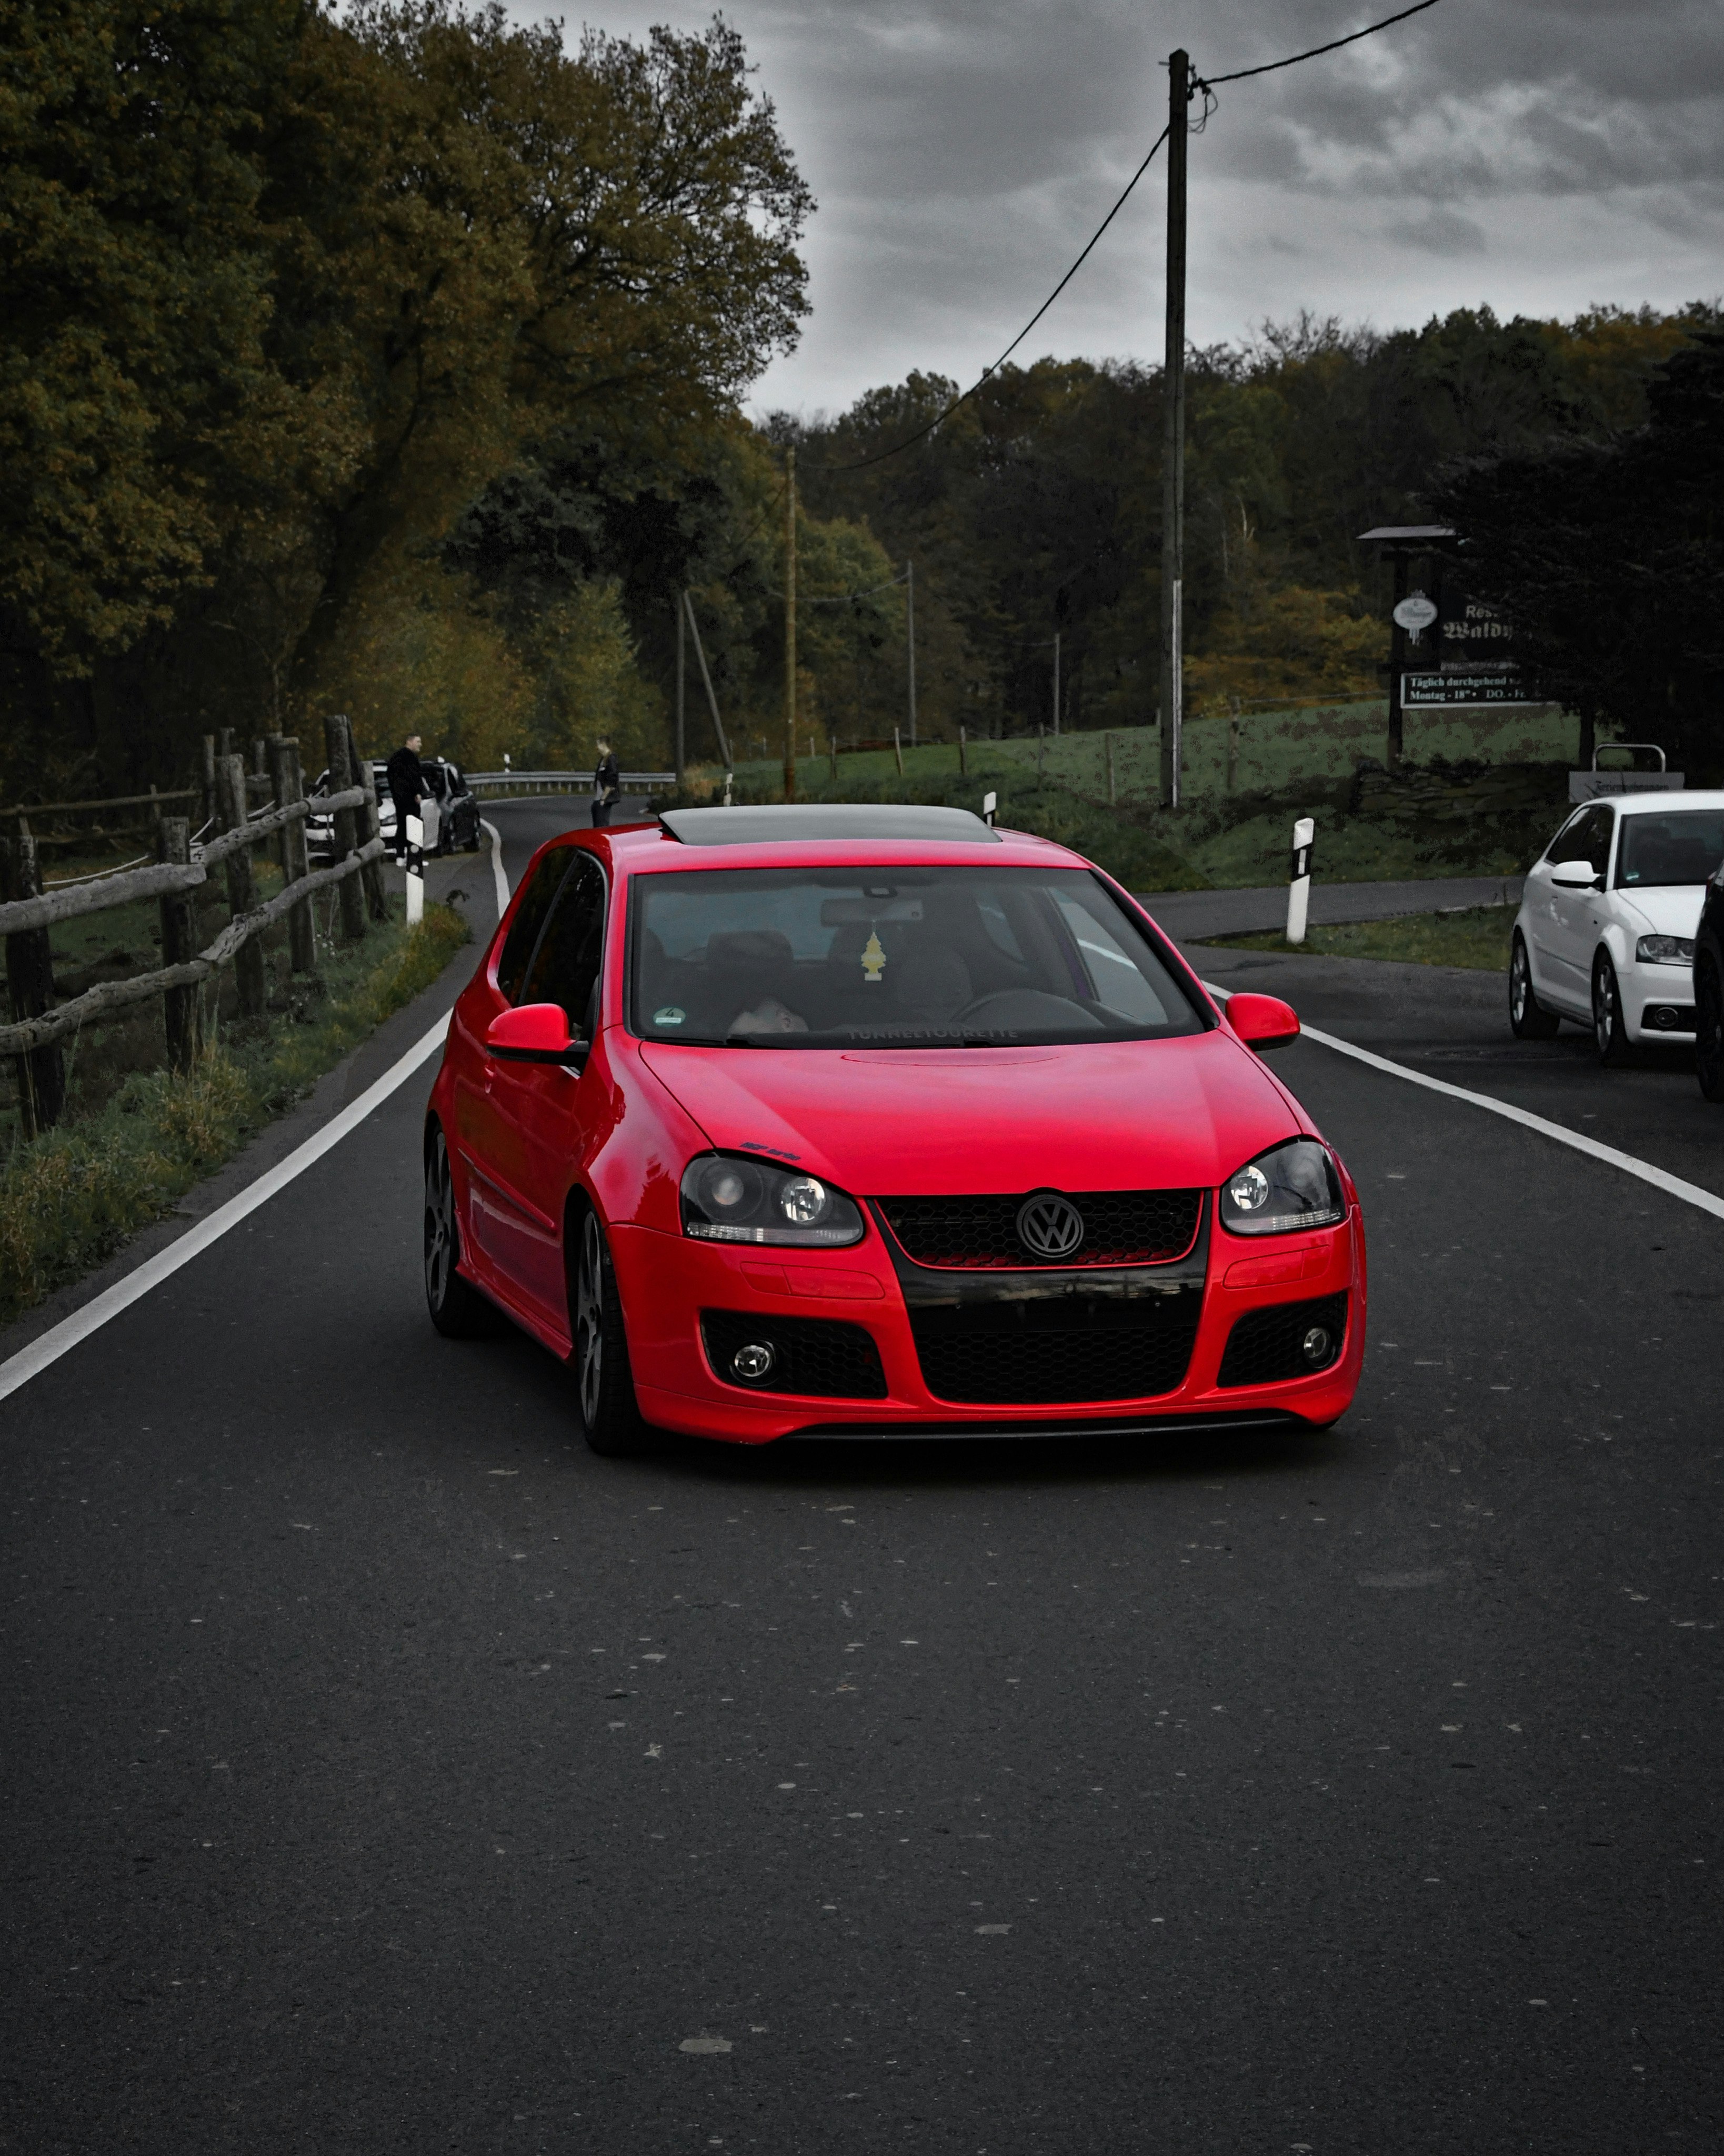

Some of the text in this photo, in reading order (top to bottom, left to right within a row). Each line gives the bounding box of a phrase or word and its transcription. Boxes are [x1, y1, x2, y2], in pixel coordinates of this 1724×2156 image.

[1410, 677, 1445, 688] Täglich
[1447, 676, 1507, 688] durchgehend
[1410, 690, 1446, 701] Montag
[665, 1007, 674, 1017] 4
[847, 1027, 1018, 1040] TUNNELTOURETTE
[1022, 1199, 1080, 1253] VW
